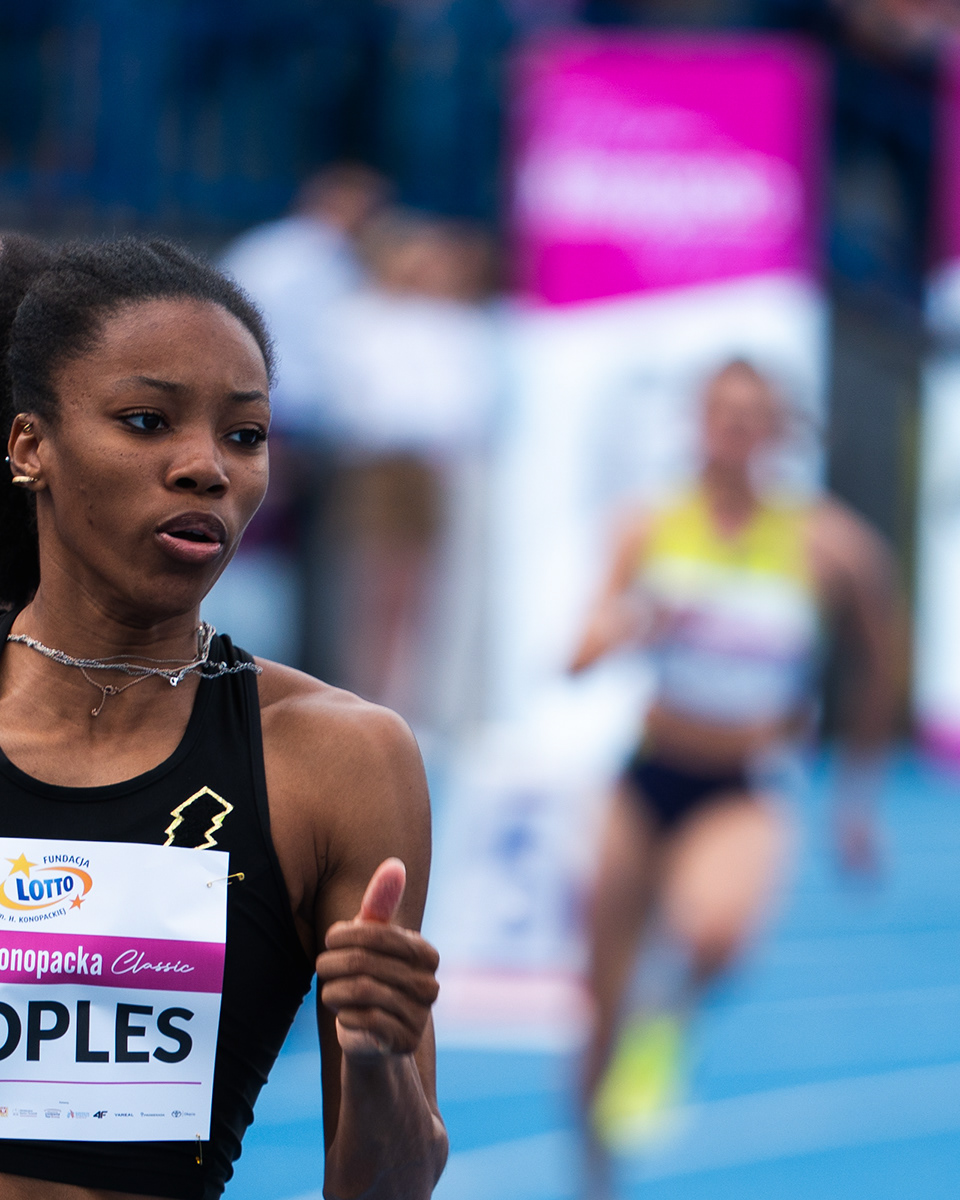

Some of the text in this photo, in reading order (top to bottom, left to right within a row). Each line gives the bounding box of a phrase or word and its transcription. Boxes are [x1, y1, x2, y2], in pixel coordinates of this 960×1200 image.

[43, 854, 90, 868] FUNDACJA
[15, 875, 74, 902] LOTTO
[8, 915, 16, 923] H.
[18, 907, 67, 923] KONOPACKIEJ
[110, 949, 195, 975] Classic
